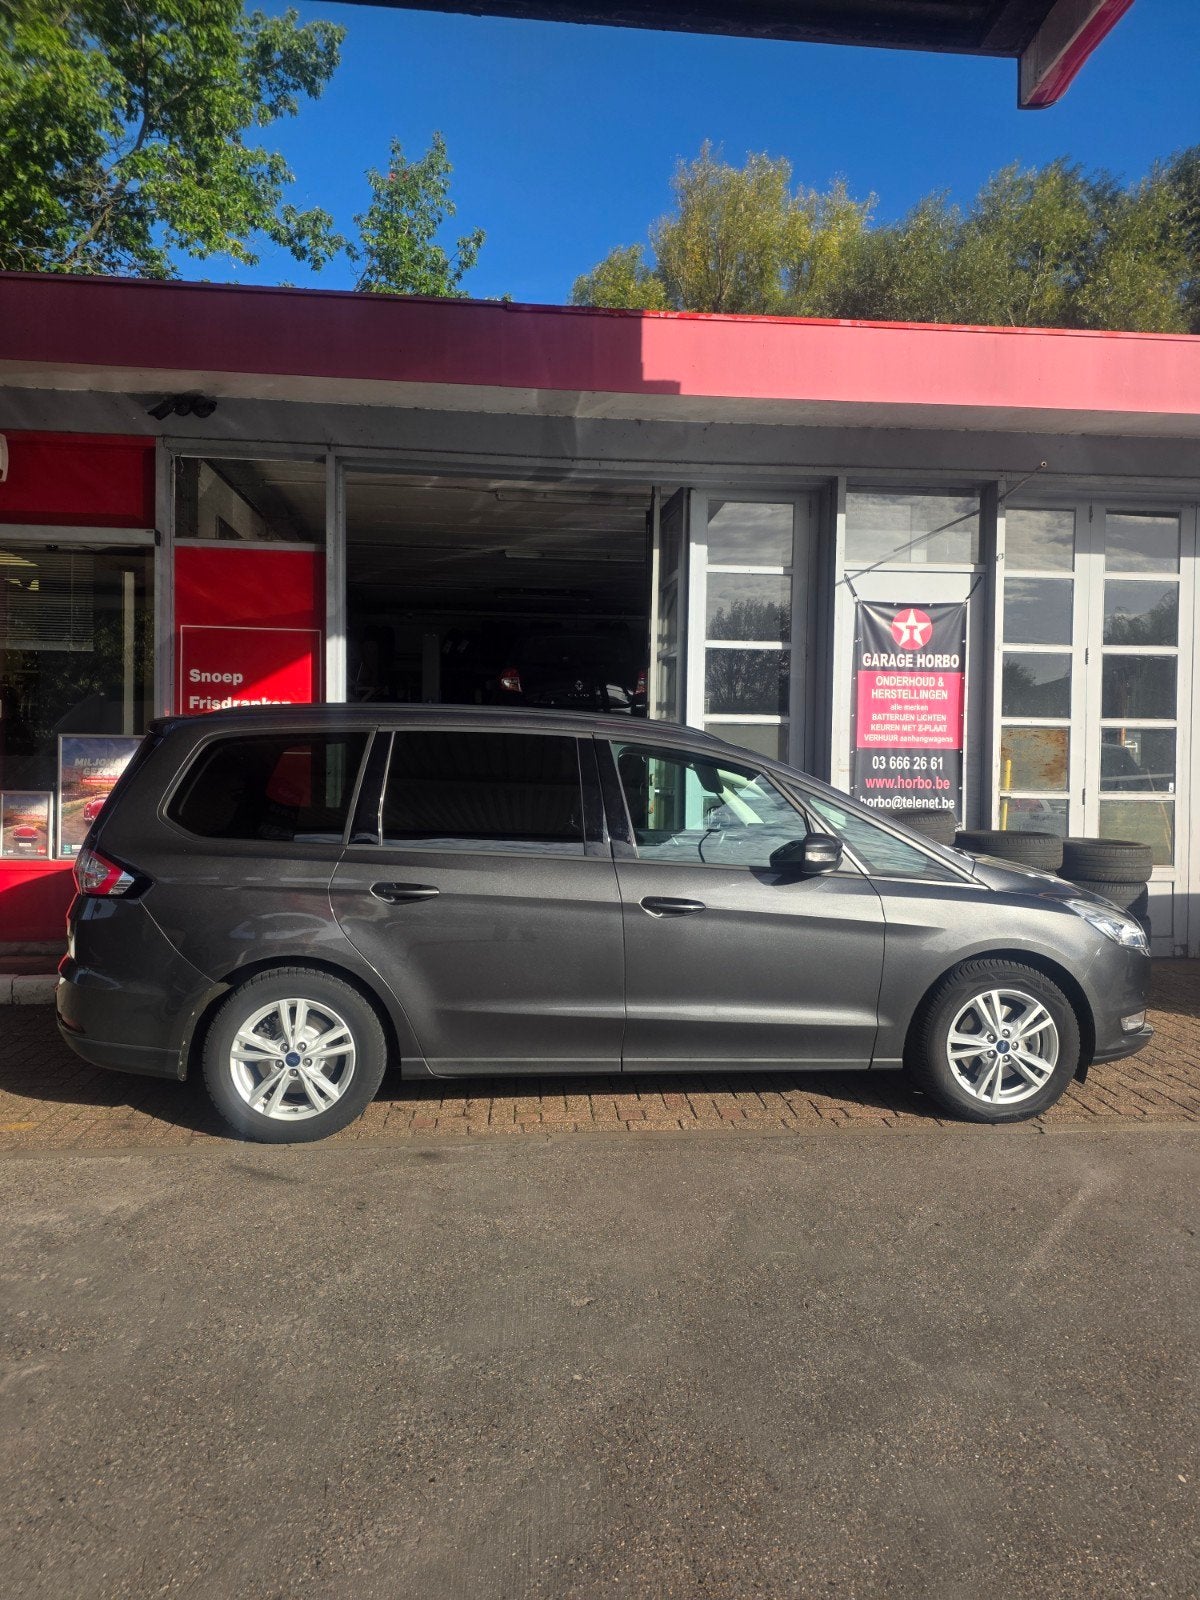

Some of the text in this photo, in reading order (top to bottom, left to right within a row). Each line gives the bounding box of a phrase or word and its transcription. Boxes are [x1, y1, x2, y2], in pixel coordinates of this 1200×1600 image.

[862, 653, 960, 668] GARAGE HORBO
[189, 668, 243, 685] Snoep
[875, 676, 944, 687] ONDERHOUD &
[871, 689, 948, 700] HERSTELLINGEN
[189, 696, 291, 710] Frisdrank
[889, 703, 903, 711] alle
[871, 713, 947, 722] BATTERIJEN LICHTEN
[870, 723, 948, 733] KEUREN MET Z-PLAAT
[863, 734, 954, 744] VERHUUR aanhangwagens
[74, 757, 129, 767] MILJONA
[872, 756, 943, 770] 03 666 26 61
[865, 776, 951, 790] www.horbo.be
[860, 795, 955, 810] horbo@telenet.be
